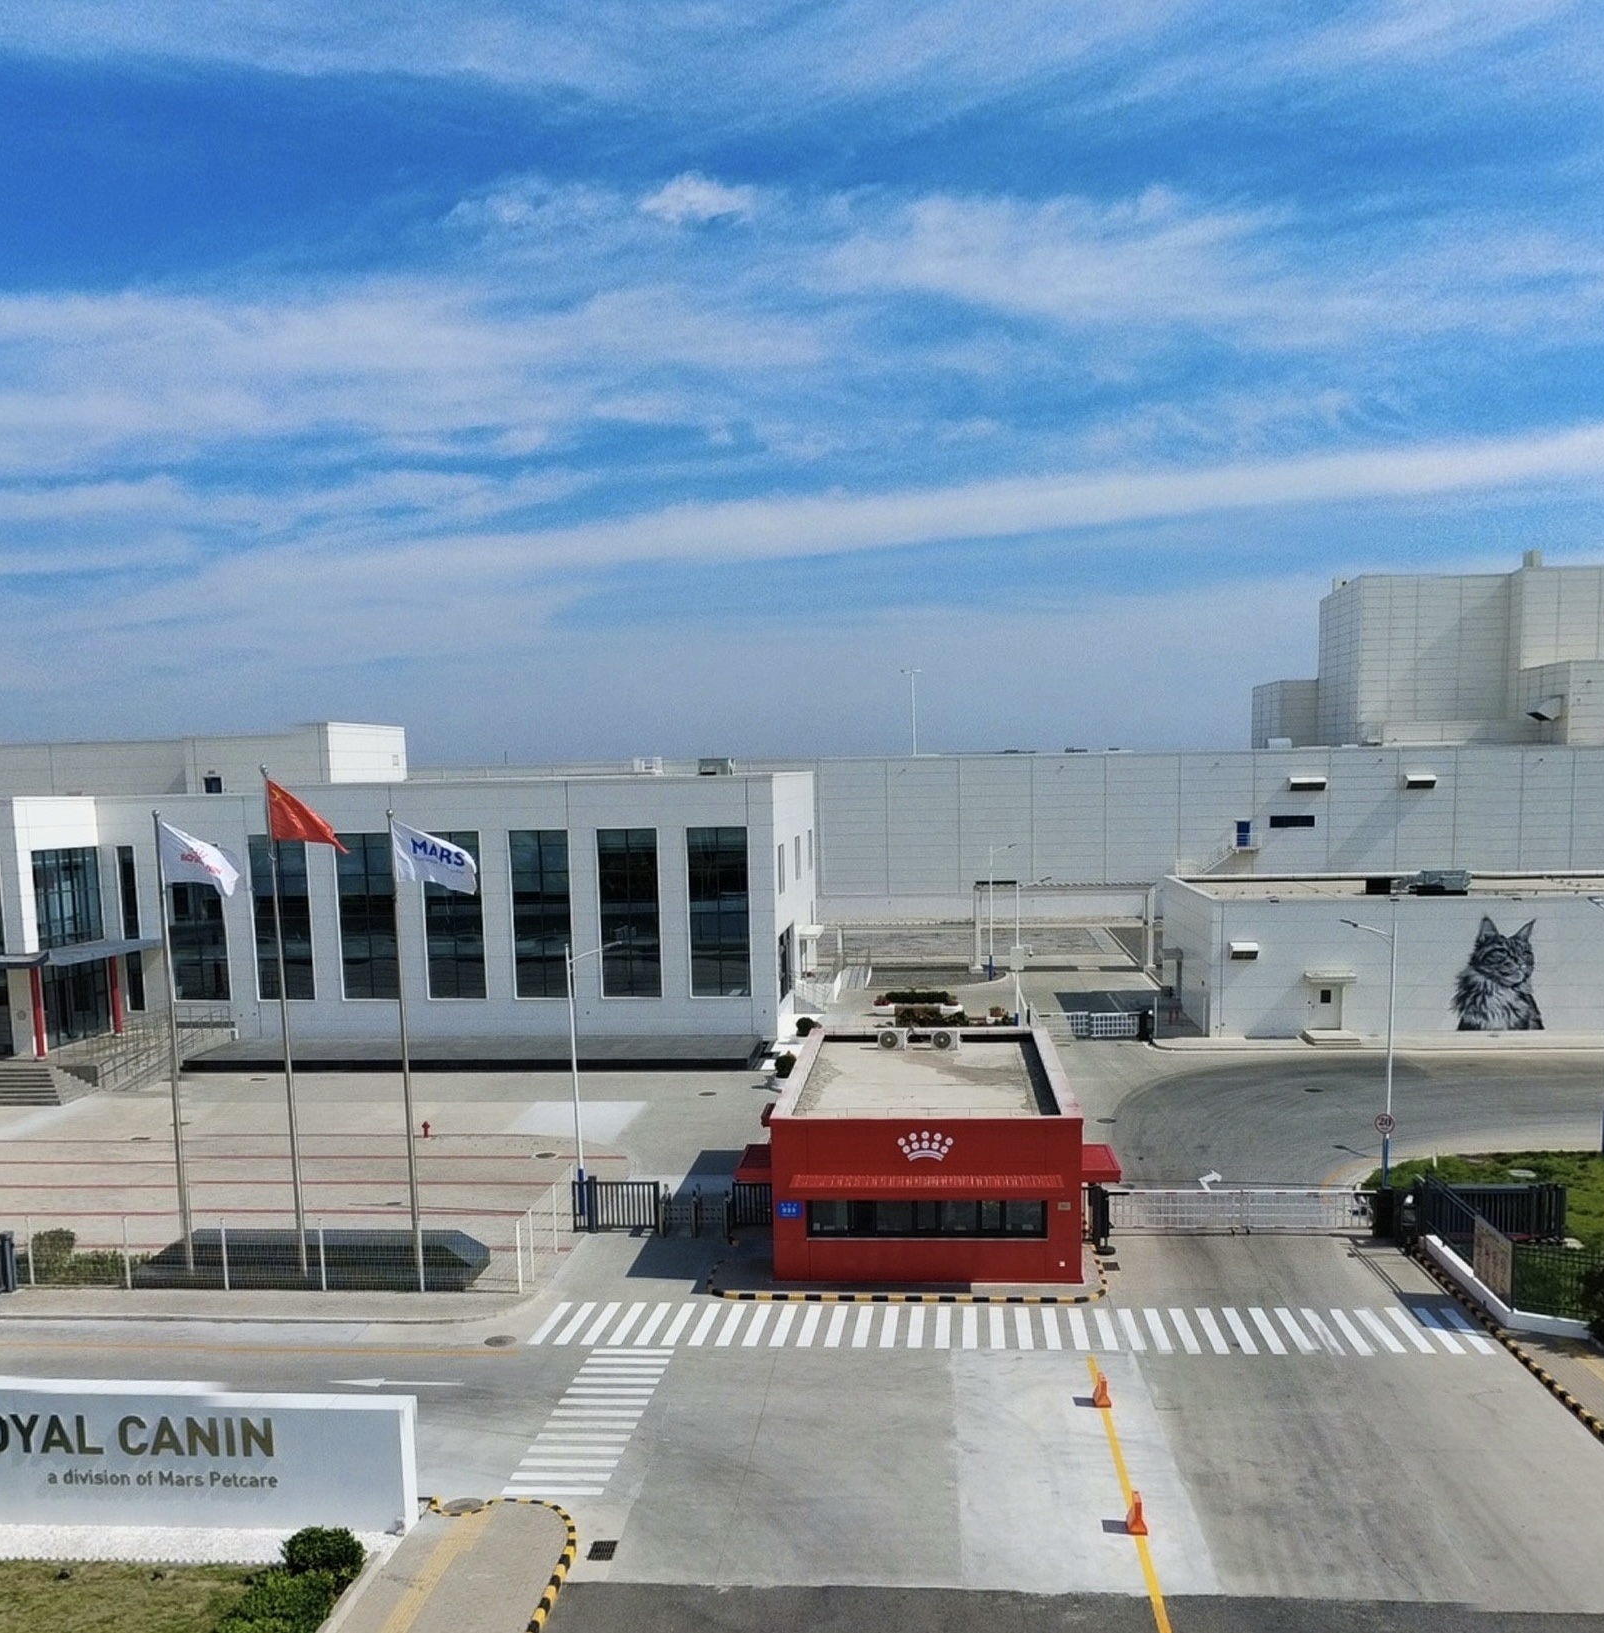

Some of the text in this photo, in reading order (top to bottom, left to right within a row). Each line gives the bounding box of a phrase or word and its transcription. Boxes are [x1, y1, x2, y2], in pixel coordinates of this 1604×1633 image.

[410, 837, 465, 867] MARS
[118, 1415, 275, 1457] CANIN
[48, 1469, 279, 1488] a division of Mars Petcare
